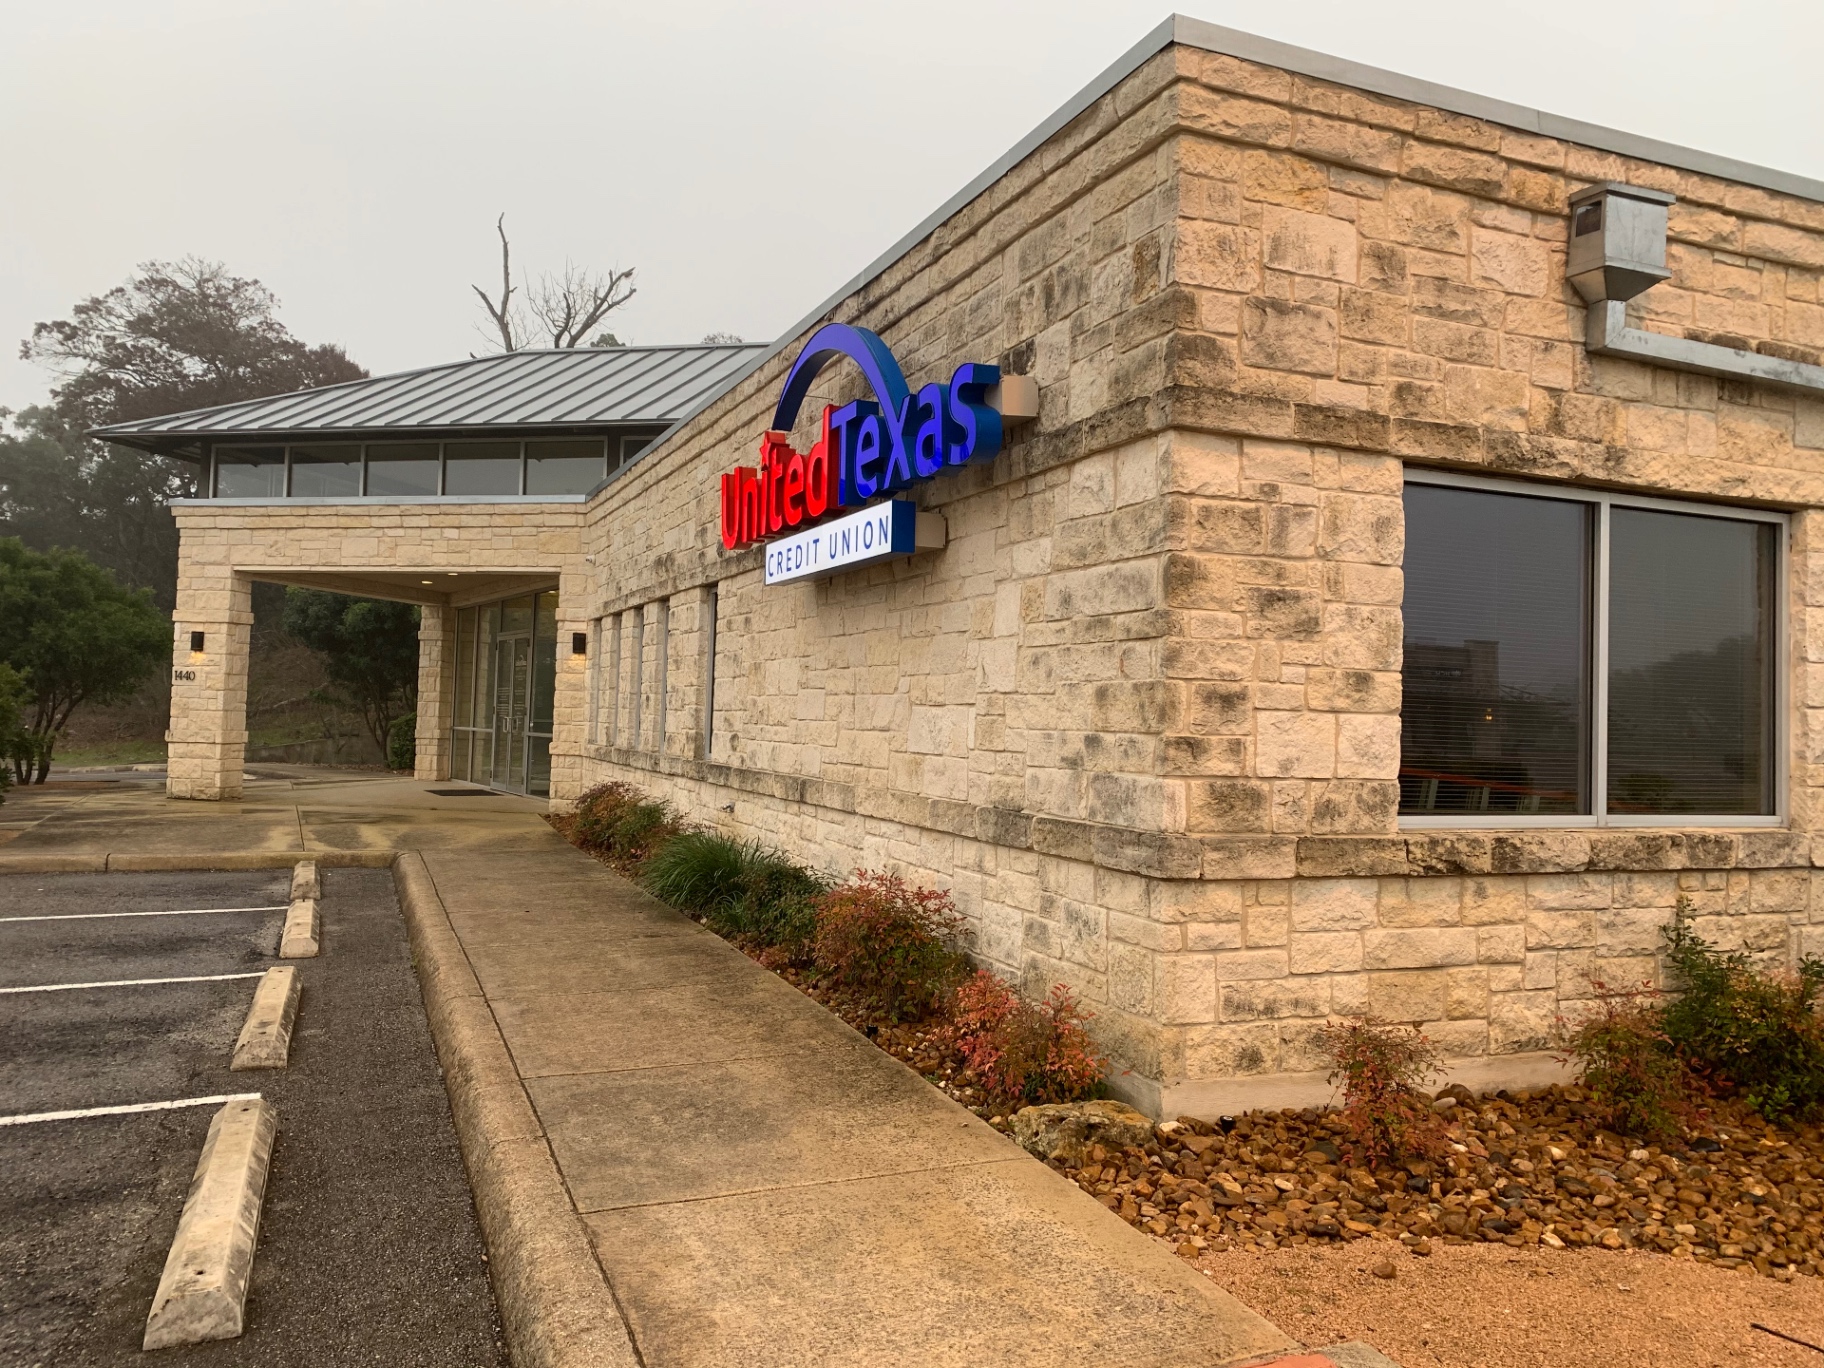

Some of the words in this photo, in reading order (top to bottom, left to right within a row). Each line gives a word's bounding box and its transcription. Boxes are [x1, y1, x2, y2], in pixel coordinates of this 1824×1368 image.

[767, 538, 820, 578] CREDIT
[829, 515, 889, 560] UNION
[174, 670, 196, 681] 1440
